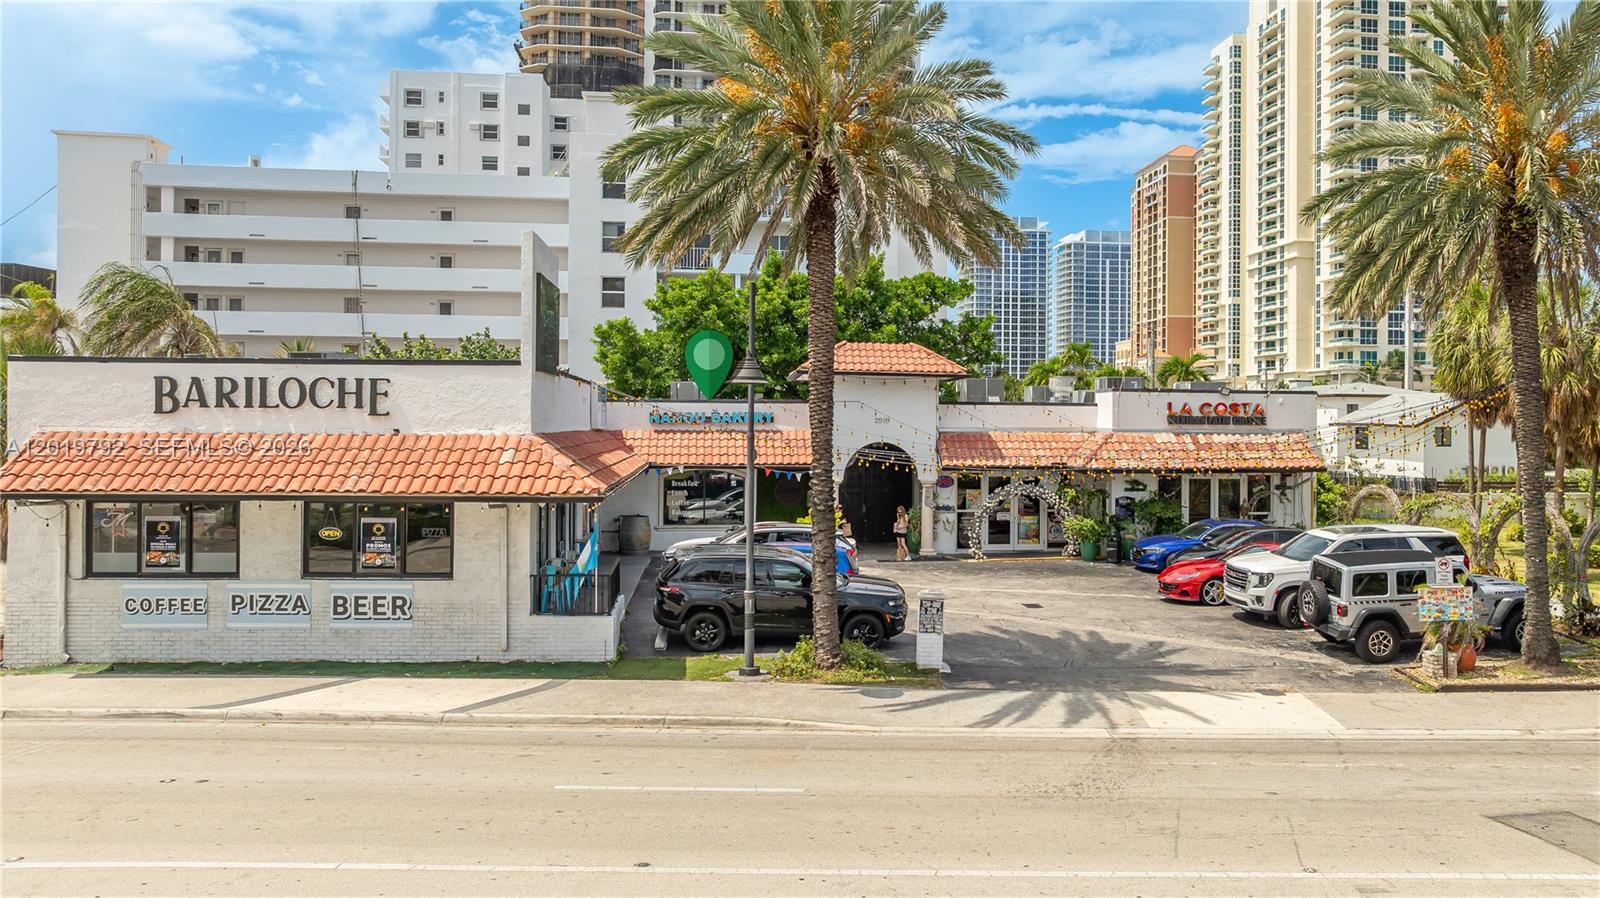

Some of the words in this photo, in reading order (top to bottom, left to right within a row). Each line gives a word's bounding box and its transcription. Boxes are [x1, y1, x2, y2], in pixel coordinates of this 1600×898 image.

[153, 376, 391, 416] BARILOCHE
[1167, 402, 1193, 416] LA
[1199, 402, 1266, 416] COSTA
[422, 528, 446, 537] PIZZA
[124, 597, 207, 616] COFFEE
[229, 593, 311, 616] PIZZA
[330, 594, 412, 621] BEER
